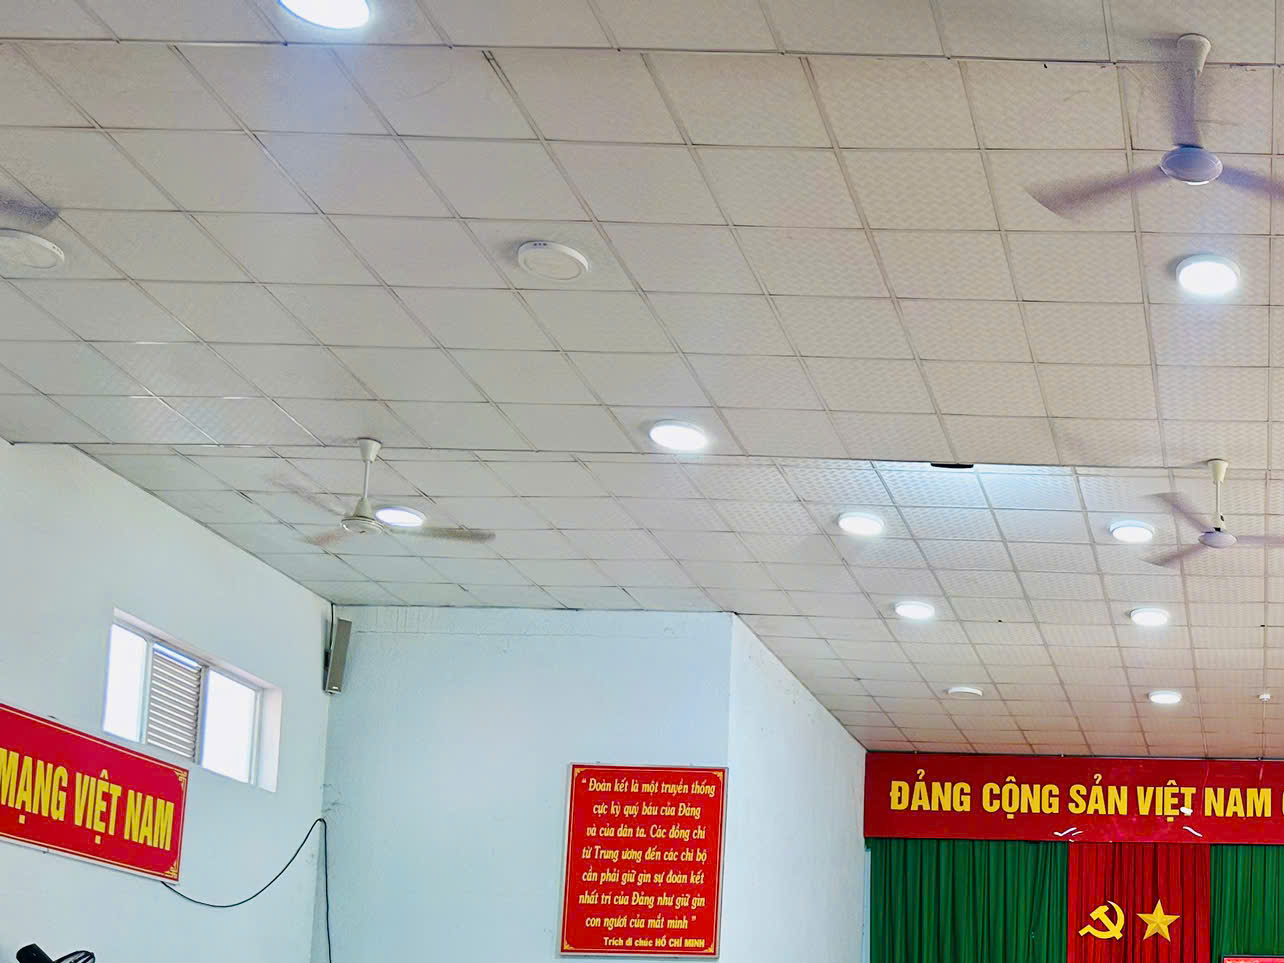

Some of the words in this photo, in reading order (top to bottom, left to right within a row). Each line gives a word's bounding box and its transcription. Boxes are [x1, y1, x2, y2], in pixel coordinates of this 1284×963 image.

[0, 747, 69, 825] MẠNG
[74, 769, 122, 845] VIỆT
[124, 789, 175, 851] NAM
[588, 777, 612, 792] Đoàn
[614, 777, 629, 792] kết
[630, 779, 639, 793] là
[641, 780, 659, 796] một
[661, 779, 689, 796] truyền
[691, 780, 716, 798] thống
[890, 769, 971, 812] ĐẢNG
[982, 776, 1060, 819] CỘNG
[1068, 774, 1128, 816] SẢN
[1136, 780, 1197, 822] VIỆT
[1204, 787, 1272, 818] NAM
